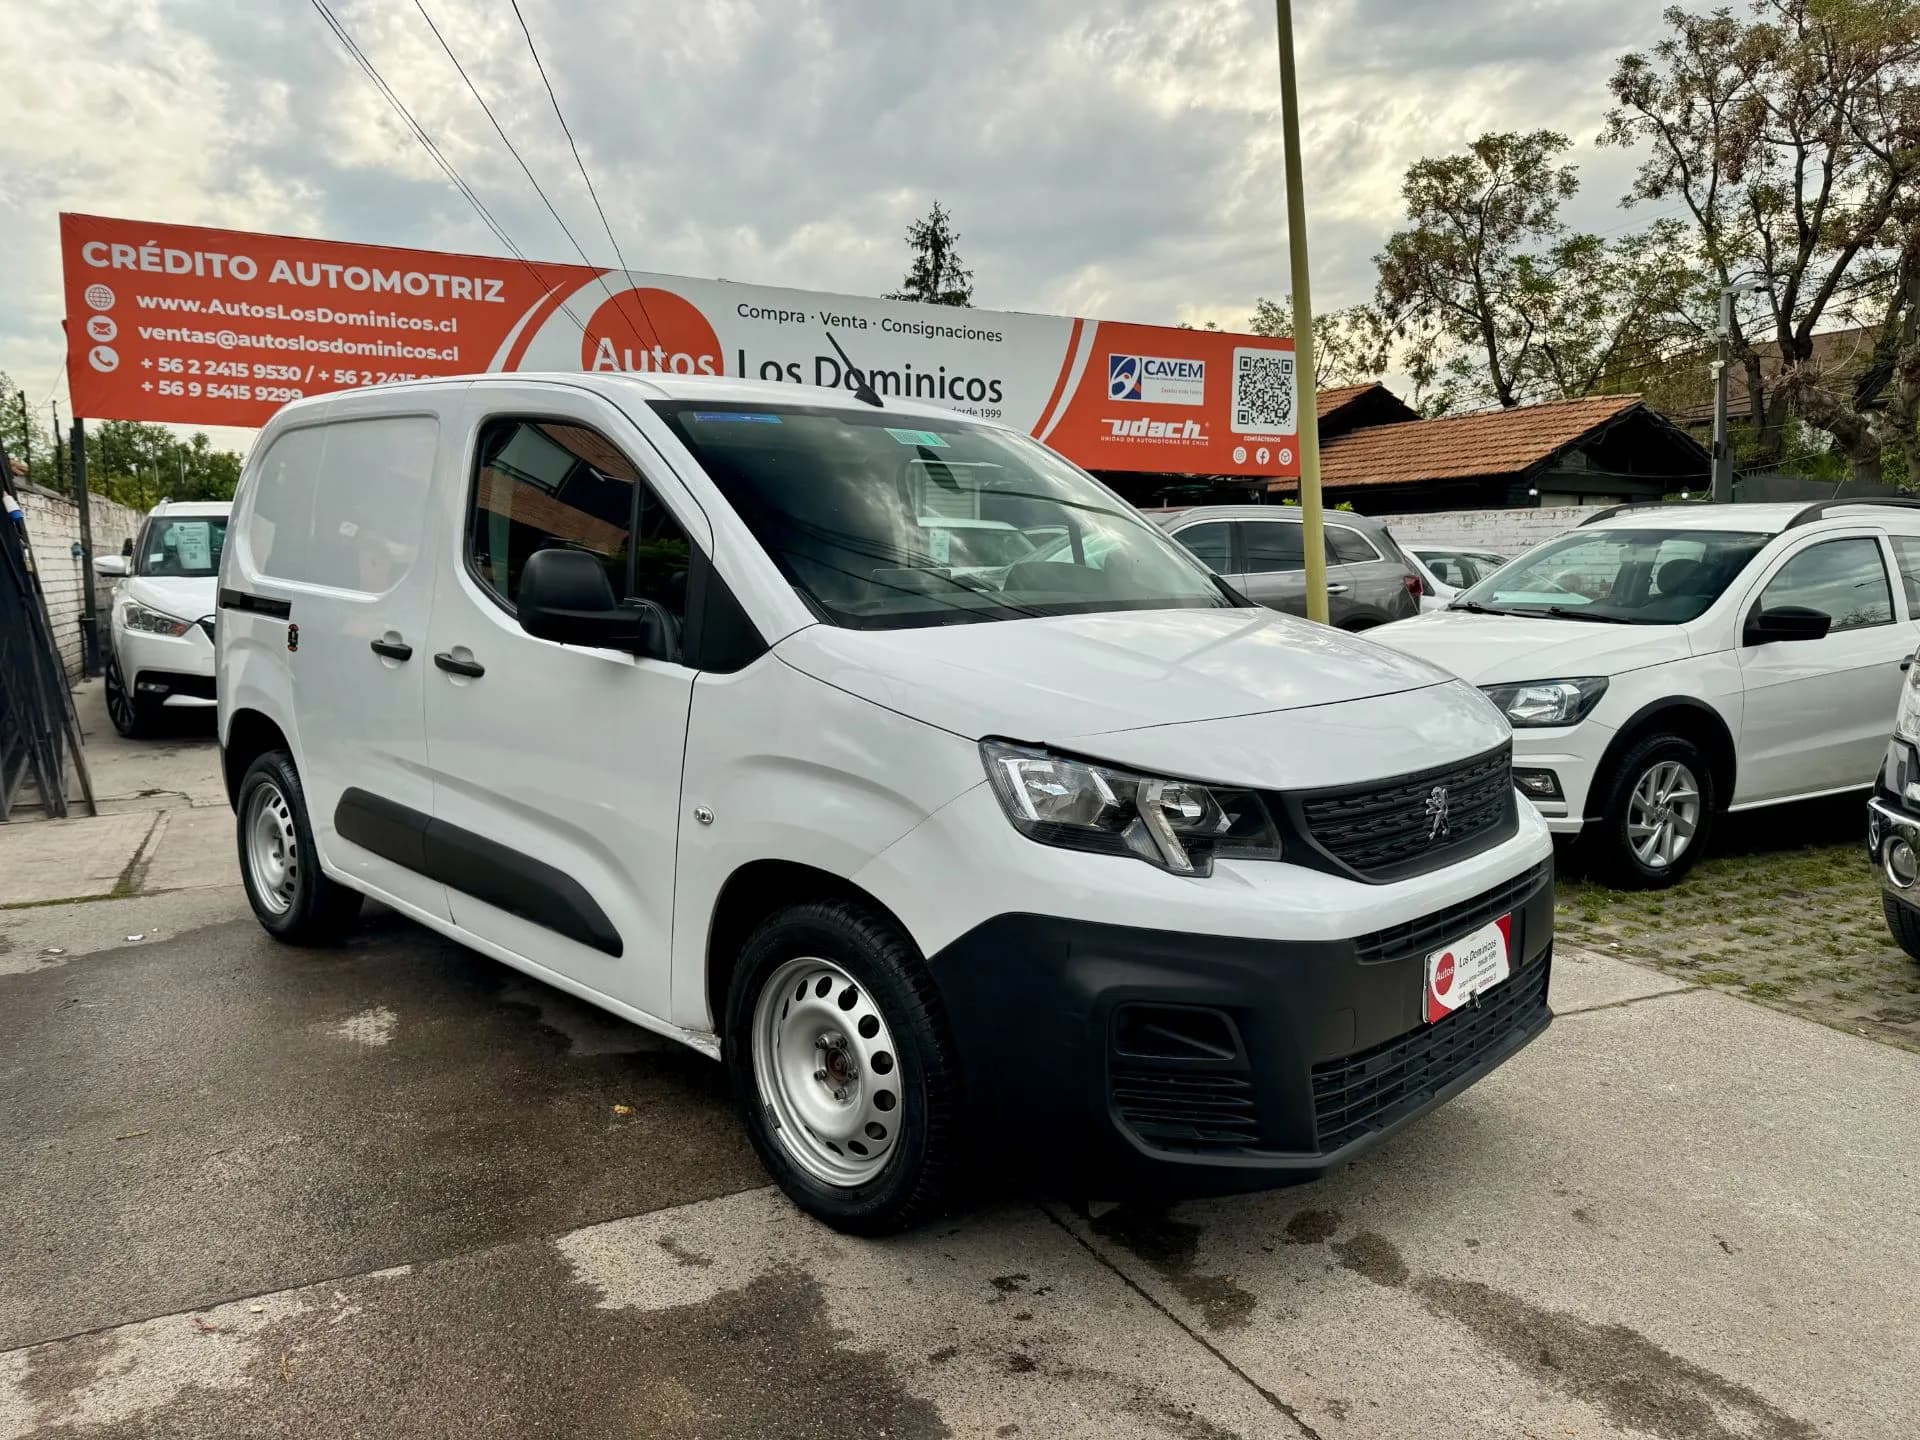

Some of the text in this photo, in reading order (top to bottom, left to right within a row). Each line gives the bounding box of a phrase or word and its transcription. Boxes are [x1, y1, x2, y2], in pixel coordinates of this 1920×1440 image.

[82, 240, 505, 303] CRÉDITO AUTOMOTRIZ
[136, 295, 457, 333] www.AutosLosDominicos.cl
[737, 303, 1003, 342] Compra Venta Consignaciones
[138, 326, 459, 361] ventas@autoslosdominicos.cl
[592, 337, 716, 376] Autos
[158, 357, 184, 373] 56
[187, 359, 201, 375] 2
[204, 360, 249, 377] 2415
[252, 363, 302, 381] 9530
[333, 368, 358, 385] 56
[360, 371, 373, 386] 2
[815, 356, 1003, 403] Dominicos
[1143, 360, 1203, 378] CAVEM
[158, 379, 184, 395] 56
[187, 382, 202, 397] 9
[206, 383, 251, 400] 5415
[254, 386, 303, 402] 9299
[980, 408, 1002, 418] 1999
[1101, 417, 1209, 440] udach
[1435, 966, 1455, 982] Autos
